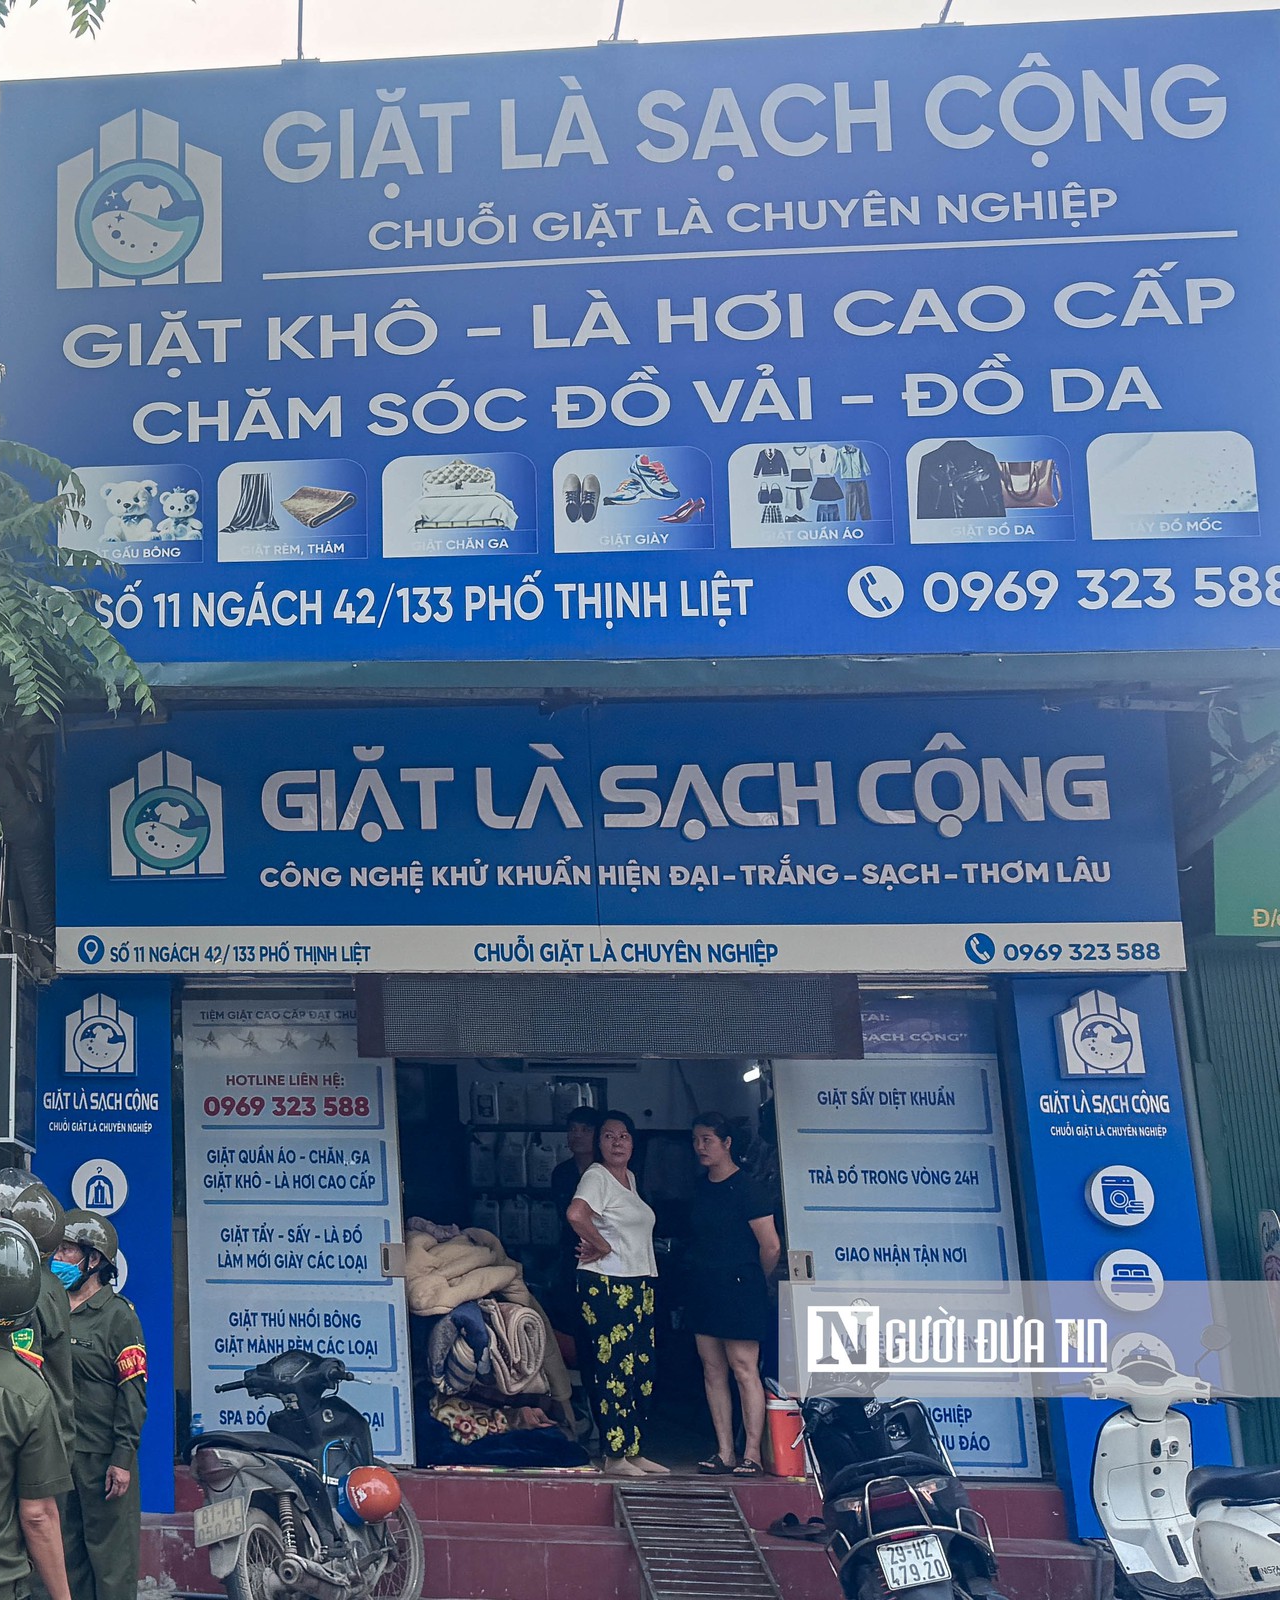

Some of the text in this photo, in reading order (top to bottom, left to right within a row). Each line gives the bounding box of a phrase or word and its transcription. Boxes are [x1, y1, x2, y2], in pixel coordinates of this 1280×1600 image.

[263, 51, 1227, 198] GIẶT LÀ SẠCH CỘNG
[369, 182, 1118, 250] CHUỖI GIẶT LÀ CHUYÊN NGHIỆP
[63, 261, 1236, 378] GIẶT KHÔ LÀ HƠI CAO CẤP
[133, 353, 1163, 445] CHĂM SÓC ĐỒ VẢI ĐỒ DA
[843, 526, 864, 539] ÁO
[1014, 524, 1035, 535] DA
[1187, 516, 1223, 531] MỐC
[446, 537, 509, 550] CHĂN GA
[635, 531, 669, 545] GIÀY
[143, 546, 181, 558] BÔNG
[95, 570, 754, 630] SỐ 11 NGÁCH 42/133 PHỐ THỊNH LIỆT
[922, 568, 1175, 613] 0969 323
[261, 732, 1112, 843] GIẶT LÀ SẠCH CỘNG
[260, 861, 342, 888] CÔNG
[350, 860, 424, 894] NGHỆ
[432, 858, 489, 886] KHỬ
[497, 855, 591, 886] KHUẨN
[598, 859, 661, 893] HIỆN
[1057, 855, 1111, 883] LÂU
[110, 941, 371, 966] SỐ 11 NGÁCH PHỐ THỊNH LIỆT
[474, 935, 779, 967] CHUỖI GIẶT LÀ CHUYÊN NGHIỆP
[1003, 941, 1161, 962] 0969 323 588
[227, 1009, 252, 1022] GIẶT
[256, 1010, 280, 1020] CAO
[226, 1072, 345, 1089] HOTLINE LIÊN HỆ:
[43, 1087, 159, 1112] GIẶT LÀ SẠCH CỘNG
[203, 1095, 370, 1117] 0969 323 588
[817, 1085, 956, 1110] GIẶT SẤY DIỆT KHUẨN
[1040, 1089, 1170, 1115] GIẶT LÀ SẠCH CỘNG
[207, 1146, 235, 1167] GIẶT
[277, 1145, 296, 1164] ÁO
[351, 1150, 370, 1164] GA
[204, 1169, 376, 1193] GIẶT KHÔ LÀ HƠI CAO CẤP
[808, 1165, 835, 1184] TRẢ
[861, 1169, 908, 1185] TRONG
[911, 1166, 951, 1185] VÒNG
[954, 1170, 979, 1185] 24H
[221, 1225, 249, 1247] GIẶT
[252, 1222, 275, 1243] TẨY
[287, 1223, 311, 1243] SẤY
[324, 1225, 339, 1243] LÀ
[218, 1250, 368, 1273] LÀM MỚI GIÀY CÁC LOẠI
[835, 1244, 967, 1267] GIAO NHẬN TẬN NƠI
[229, 1309, 258, 1331] GIẶT
[261, 1308, 285, 1328] THÚ
[324, 1309, 361, 1329] BÔNG
[214, 1335, 244, 1357] GIẶT
[247, 1335, 284, 1353] MÀNH
[317, 1335, 344, 1354] CÁC
[348, 1340, 377, 1359] LOẠI
[220, 1410, 243, 1425] SPA
[959, 1430, 990, 1452] ĐÁO
[886, 1539, 933, 1565] 29-H2
[890, 1558, 946, 1586] 479.20
